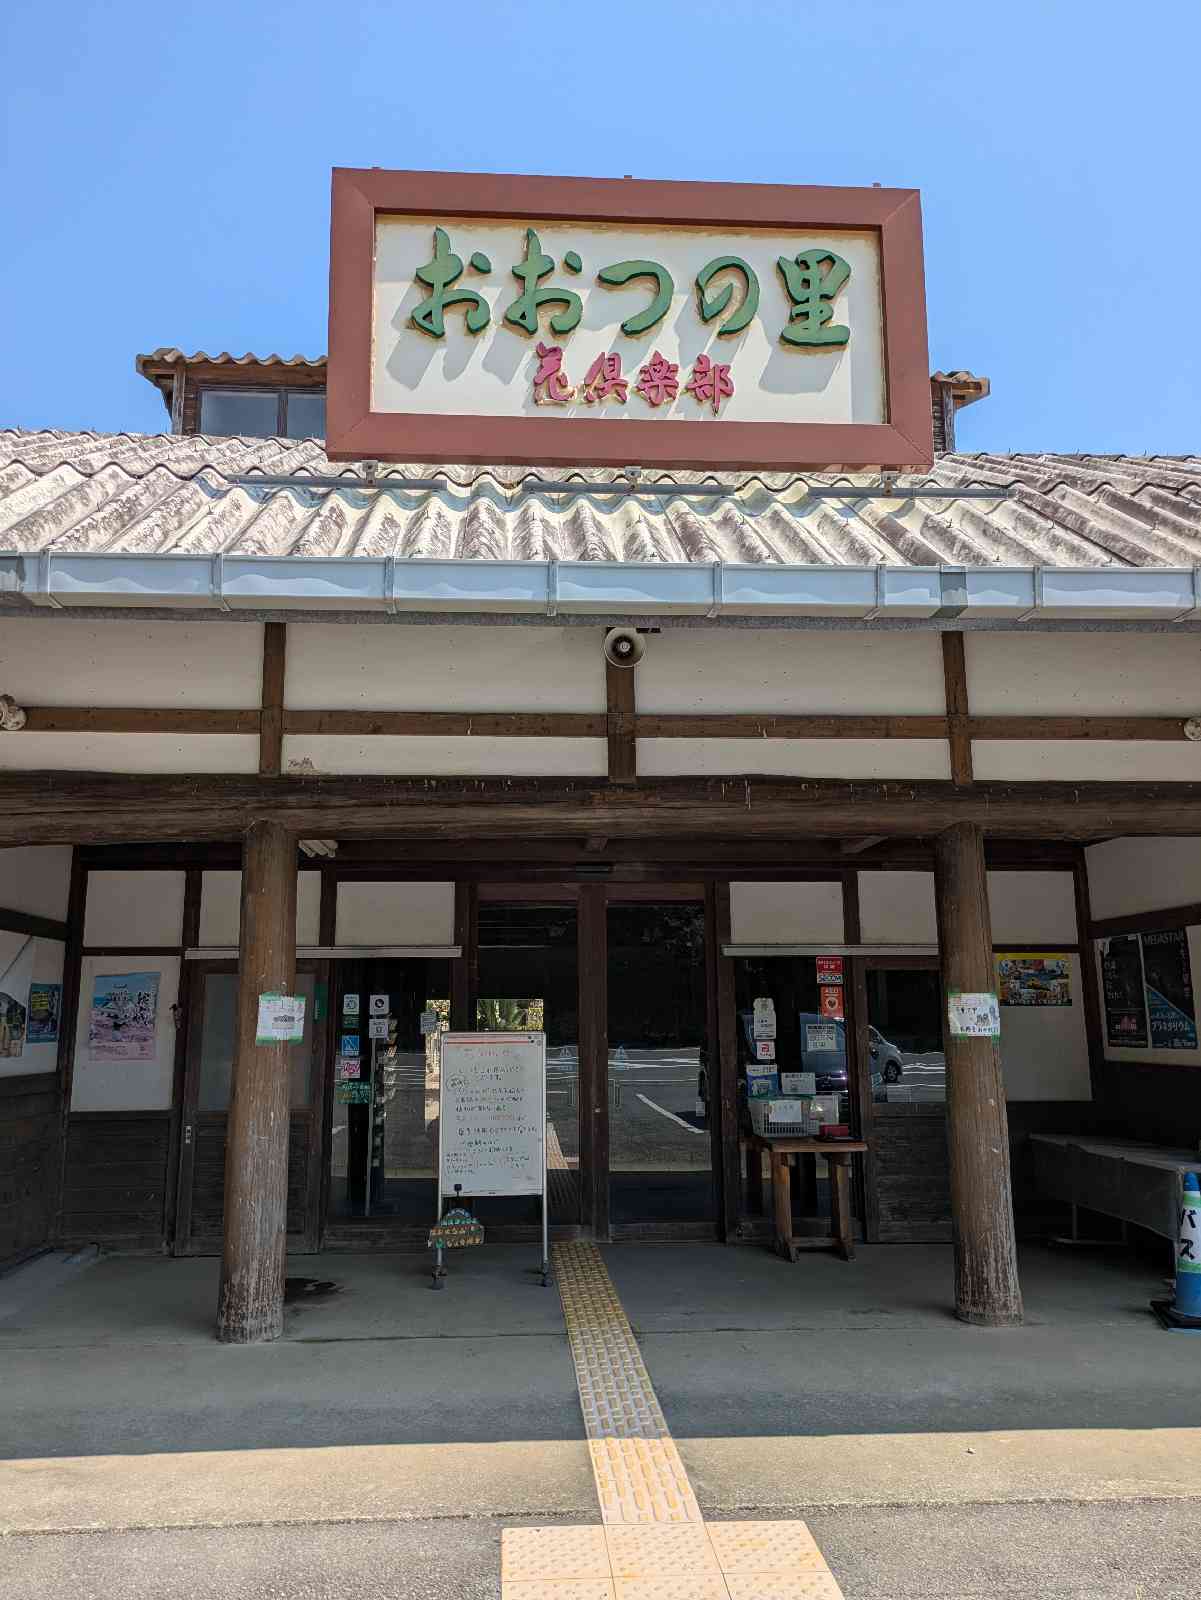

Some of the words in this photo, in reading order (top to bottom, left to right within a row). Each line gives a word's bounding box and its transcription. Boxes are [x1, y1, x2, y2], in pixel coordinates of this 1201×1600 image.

[409, 226, 852, 347] おおつの里
[534, 342, 735, 416] 花倶楽部
[1180, 1207, 1197, 1260] バス
